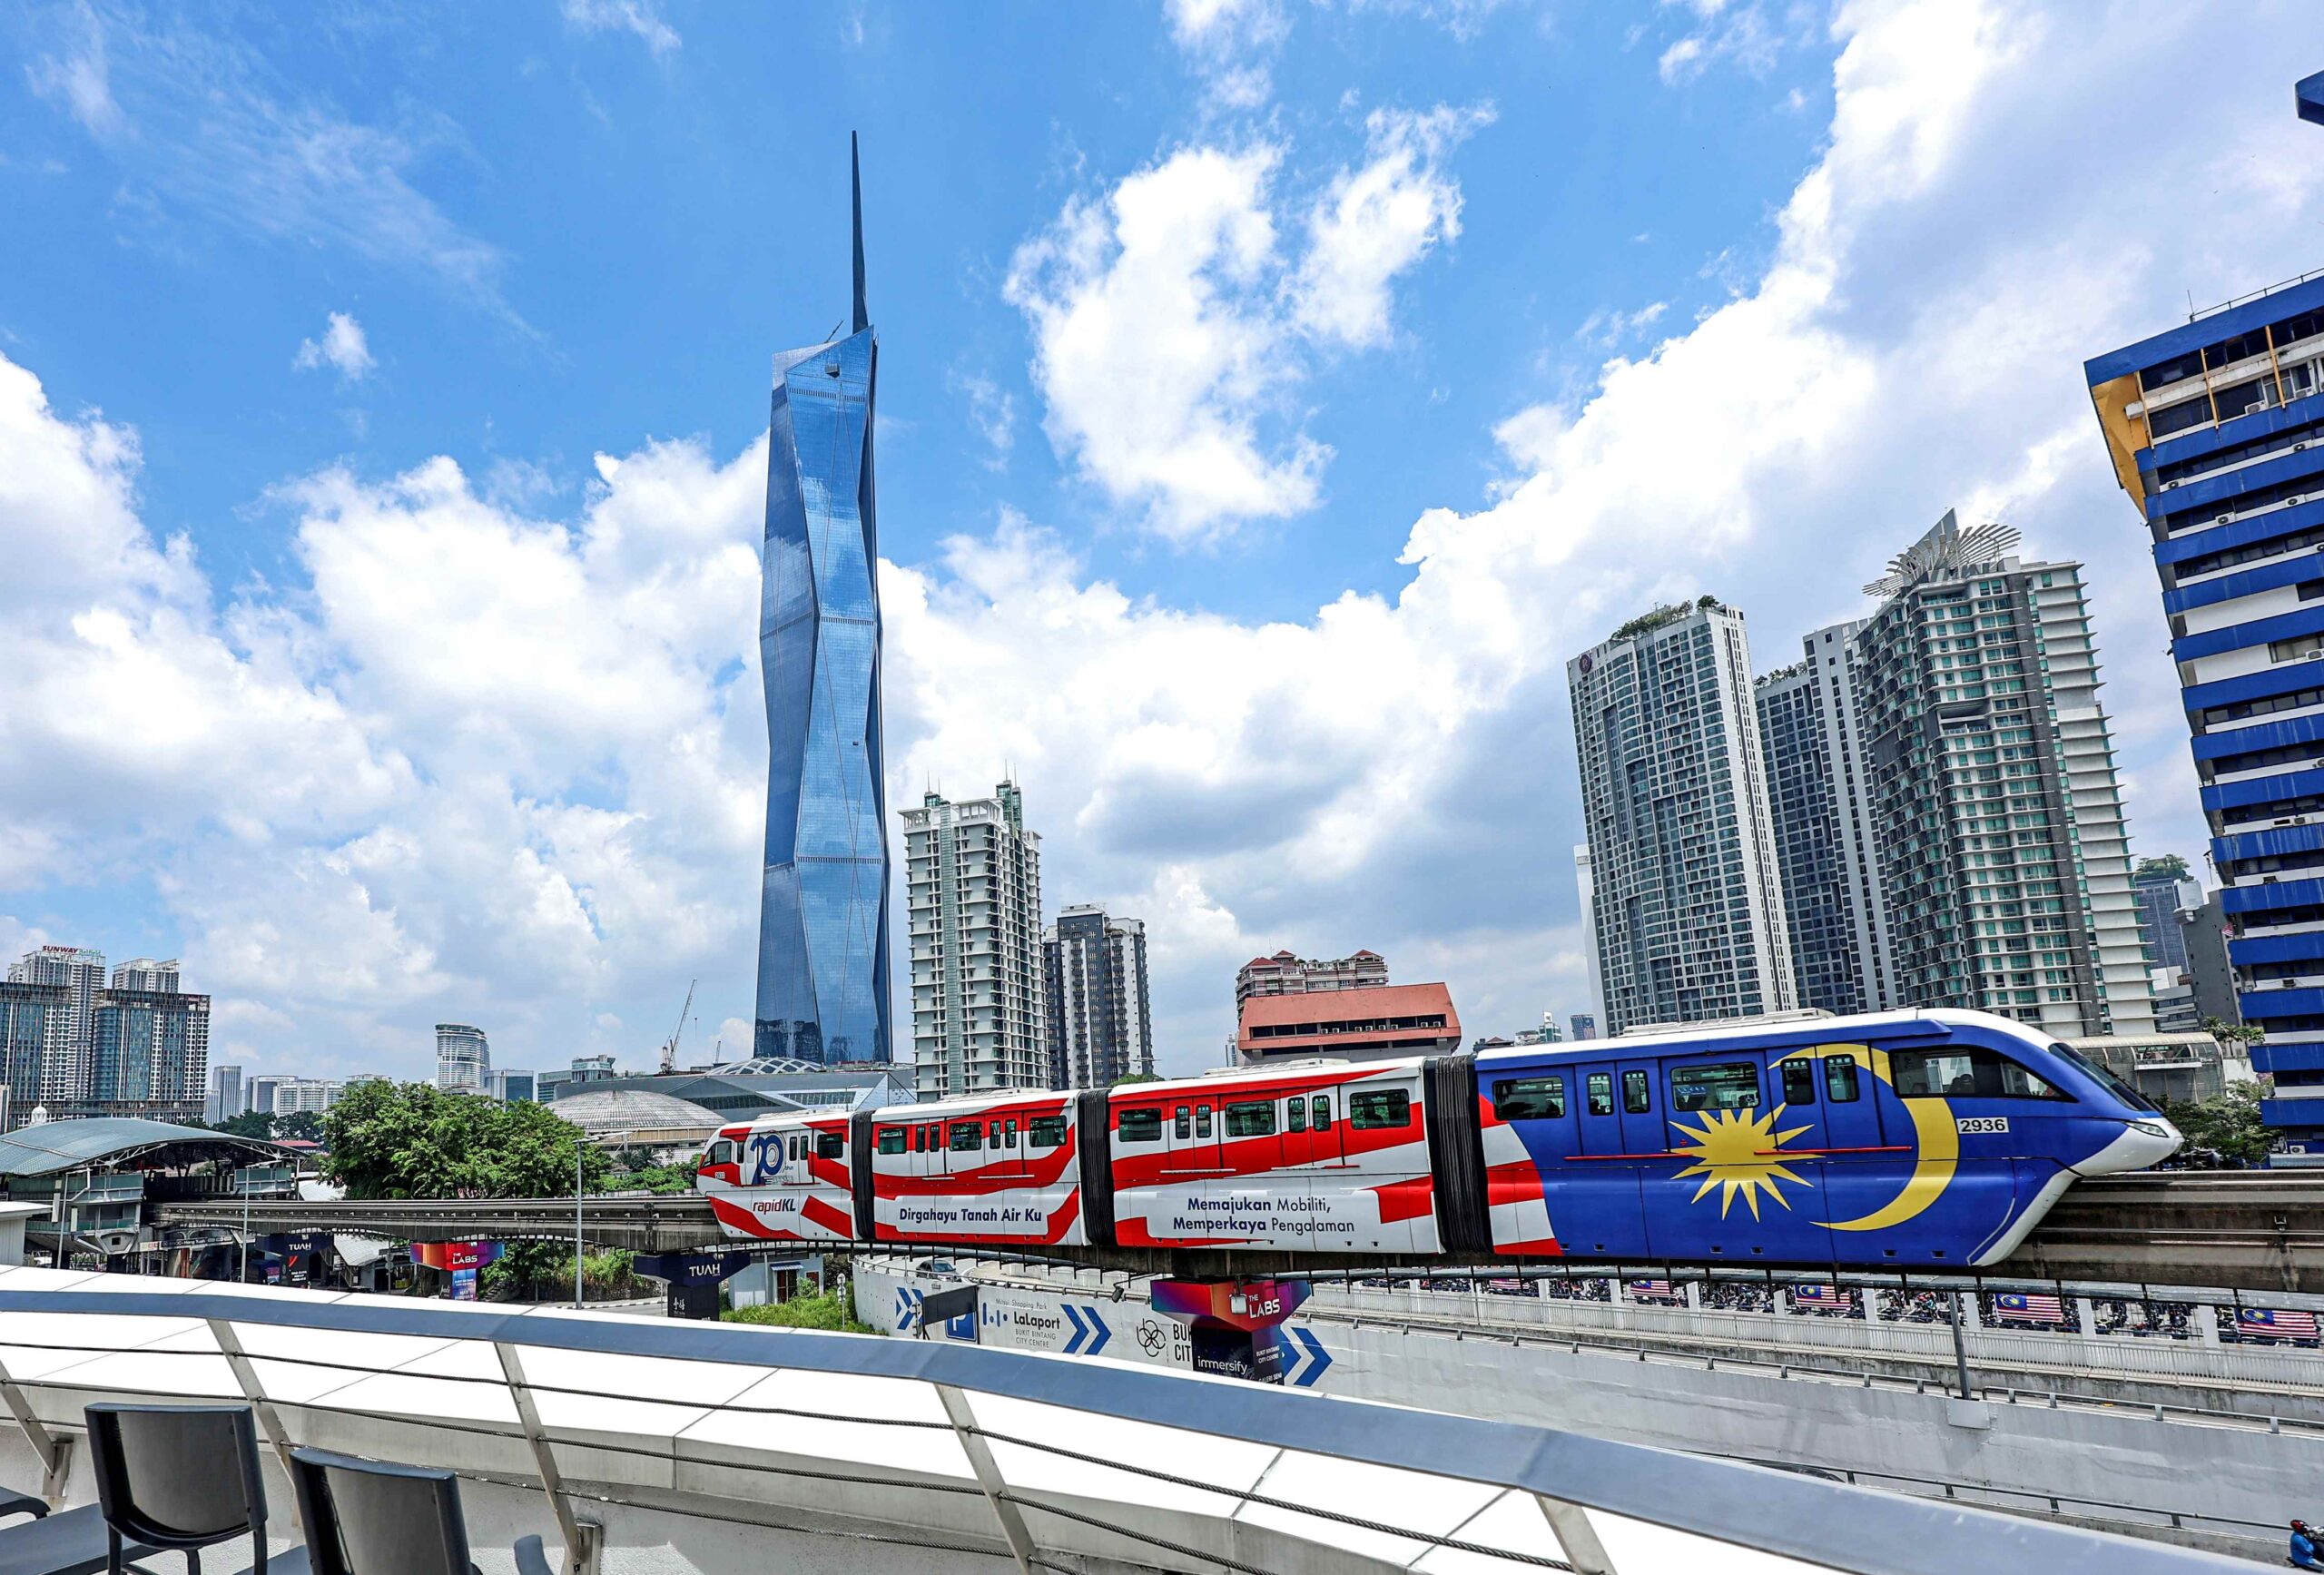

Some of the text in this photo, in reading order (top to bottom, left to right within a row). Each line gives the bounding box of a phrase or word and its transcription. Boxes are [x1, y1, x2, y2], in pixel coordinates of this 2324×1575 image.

[42, 945, 78, 953] SUNWAY
[1960, 1118, 2005, 1132] 2936
[750, 1135, 784, 1186] 20
[753, 1198, 796, 1215] rapidKL
[1187, 1196, 1331, 1215] Memajukan Mobiliti,
[900, 1208, 1042, 1224] Dirgahayu Tanah Air Ku
[1173, 1216, 1354, 1235] Memperkaya Pengalaman
[289, 1243, 311, 1251] TUAH
[452, 1255, 478, 1265] LABS
[689, 1263, 721, 1277] TUAH
[1011, 1299, 1034, 1310] Shopping
[1248, 1294, 1259, 1302] THE
[1249, 1298, 1281, 1319] LABS
[1013, 1311, 1060, 1331] LaLaport
[1015, 1329, 1057, 1340] BUKIT BINTANG
[1016, 1337, 1049, 1348] CITY CENTRE
[1174, 1344, 1191, 1362] CIT
[1197, 1355, 1248, 1375] immersify
